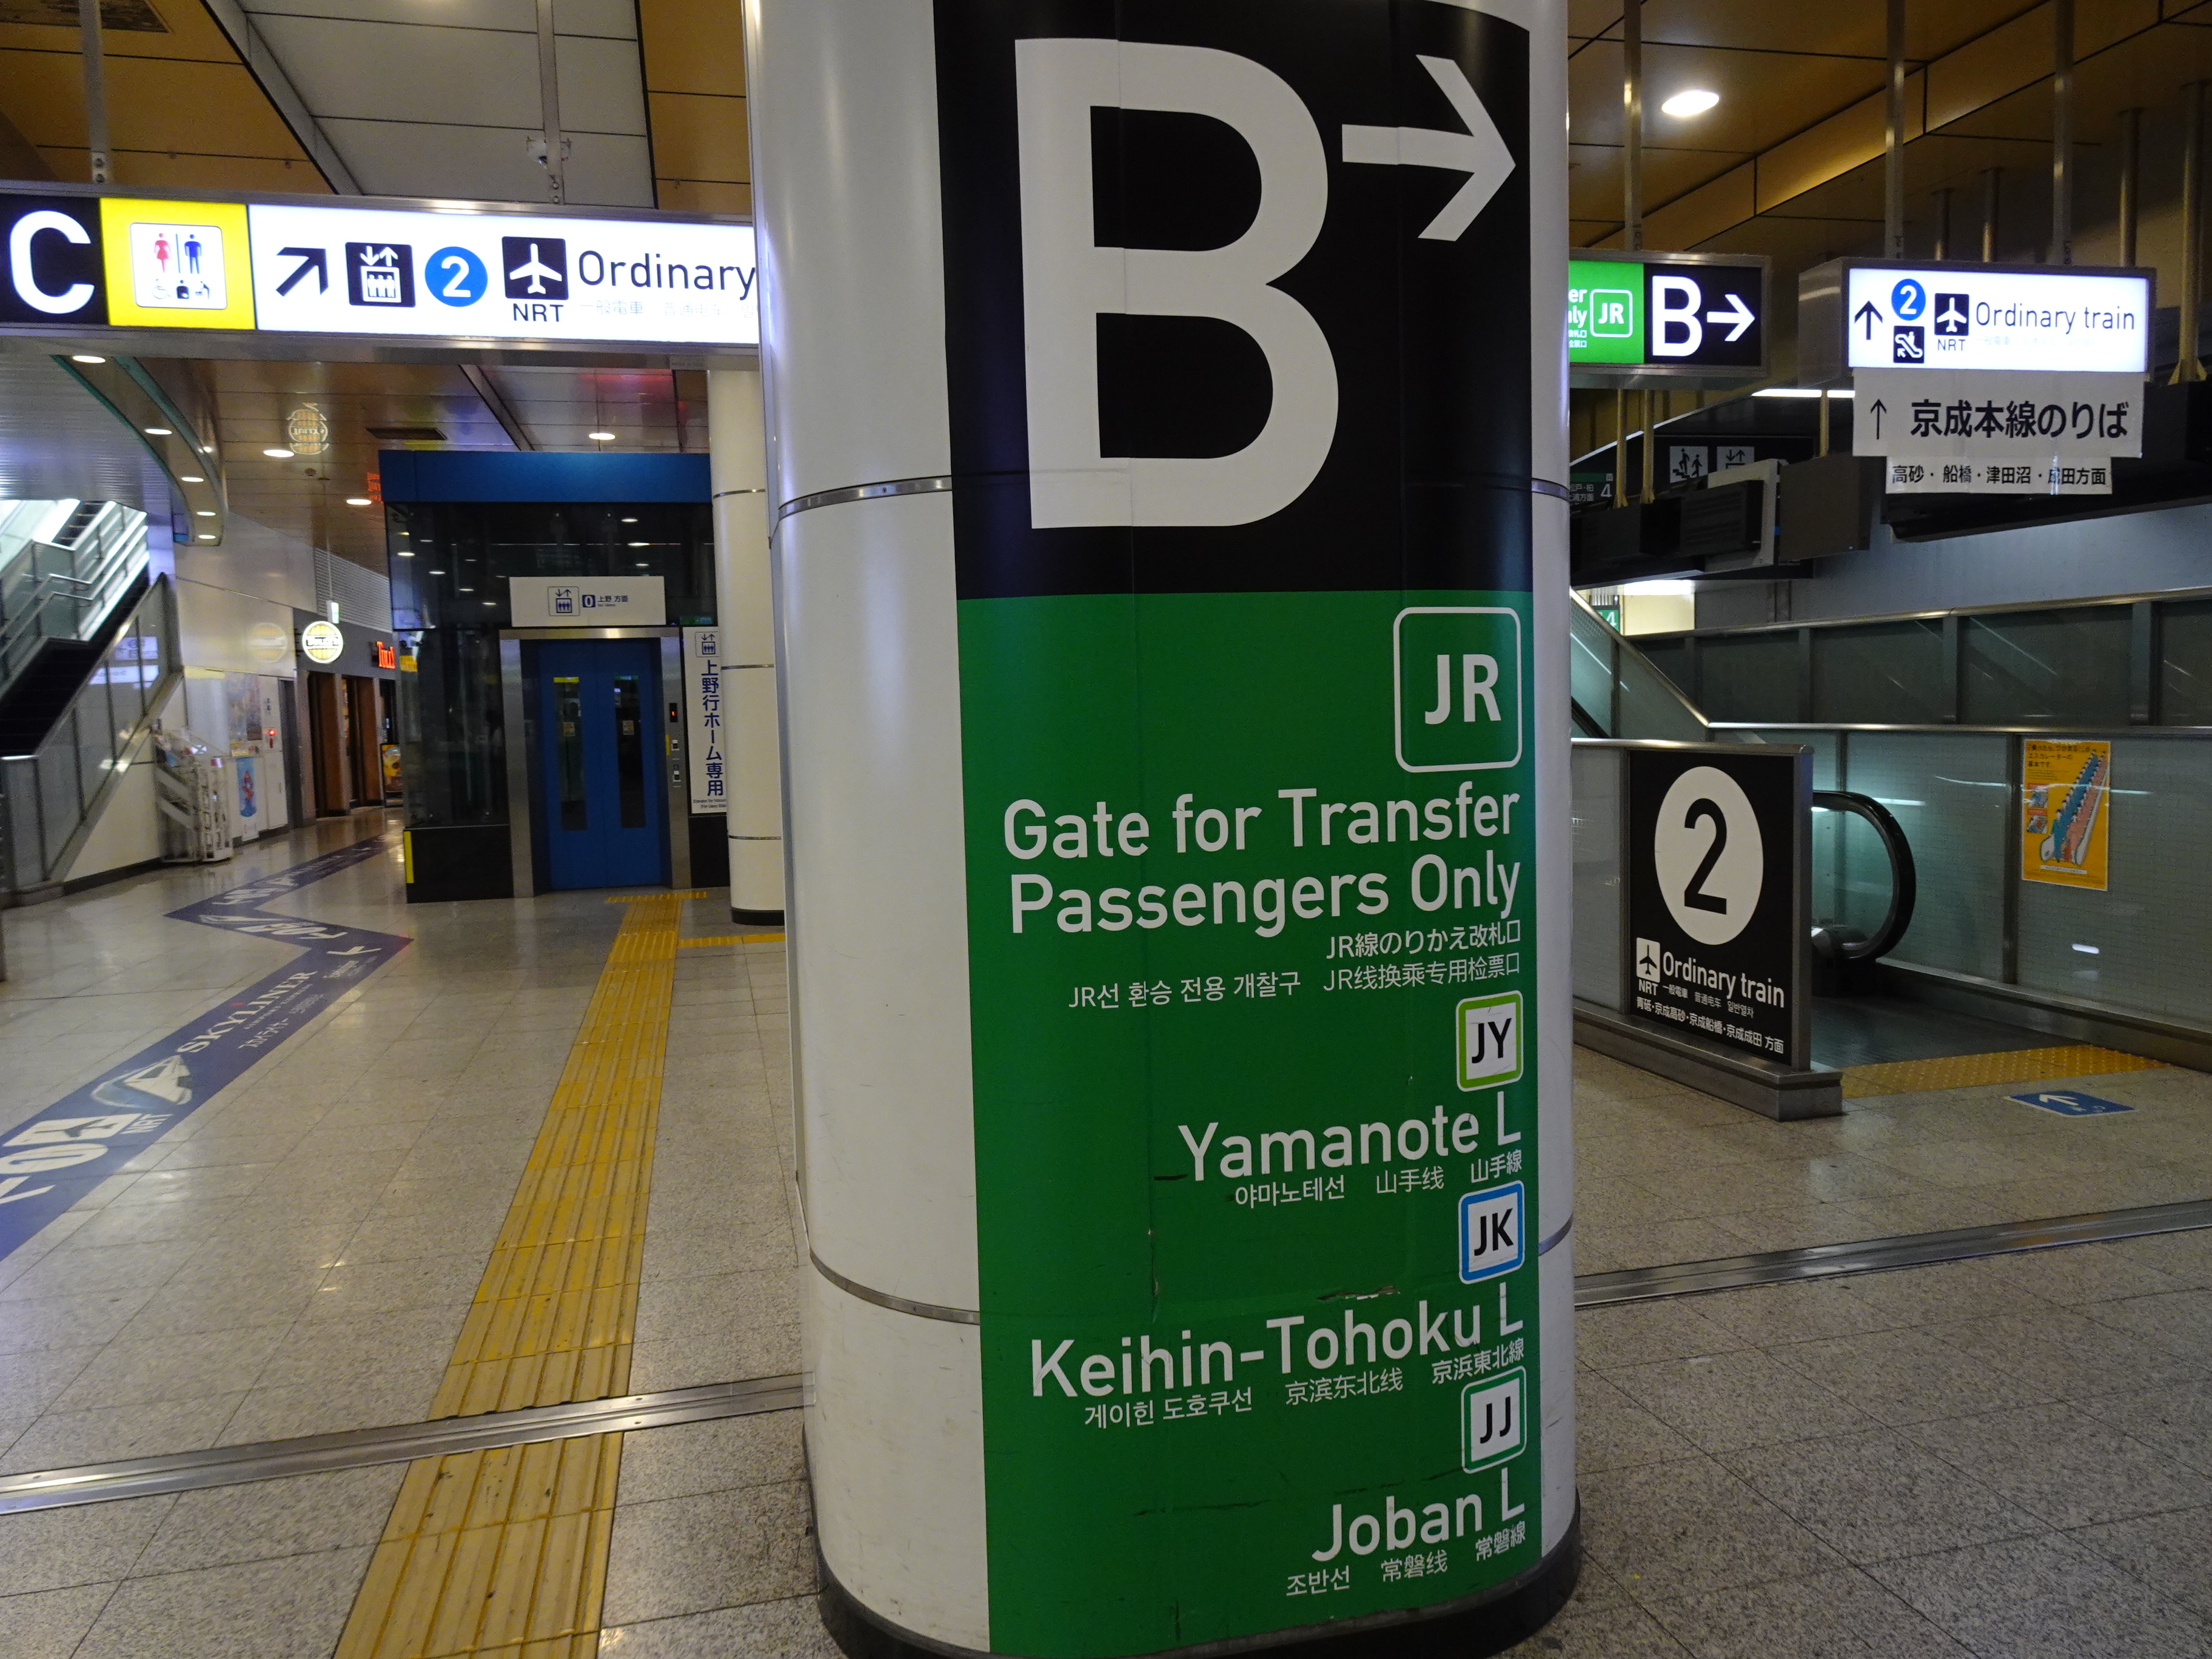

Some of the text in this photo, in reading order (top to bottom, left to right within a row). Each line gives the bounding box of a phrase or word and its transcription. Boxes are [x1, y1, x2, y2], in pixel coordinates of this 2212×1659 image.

[10, 211, 94, 313] C
[441, 255, 472, 298] 2
[579, 247, 756, 300] Ordinary
[1015, 38, 1339, 529] B
[514, 304, 563, 321] NRT
[1598, 303, 1624, 324] JR
[1652, 276, 1702, 356] B
[1900, 286, 1917, 314] 2
[1977, 302, 2134, 334] Ordinary train
[1937, 338, 1967, 352] NRT
[1911, 399, 2129, 438] 京成本線のりば
[1601, 483, 1612, 497] 4
[1425, 654, 1501, 724] JR
[700, 659, 723, 796] 上野行ホーム専用
[1005, 781, 1520, 859] Gate for Transfer
[1684, 797, 1727, 915] 2
[1011, 848, 1521, 938] Passengers Only
[1326, 919, 1521, 959] JR線のりかえ改札口
[1069, 953, 1521, 1008] JR선 환승 전용 개찰구 JR线换乘专用检票口
[1638, 979, 1659, 997] NRT
[1661, 949, 1783, 1010] Ordinary train
[1662, 984, 1689, 999] 一般電車
[176, 971, 318, 1053] SKYLINER
[1470, 1016, 1513, 1065] JY
[1764, 1036, 1785, 1054] 方面
[120, 1114, 173, 1134] NRT
[1178, 1091, 1521, 1185] Yamanote L
[1235, 1150, 1523, 1208] 야마노테선 山手线 山手線
[1473, 1208, 1515, 1256] JK
[1031, 1282, 1524, 1398] Keihin-Tohoku L
[1085, 1337, 1525, 1430] 게이힌 도호쿠선 京滨东北线 京浜東北線
[1480, 1396, 1512, 1444] JJ
[1312, 1467, 1526, 1562] Joban L
[1285, 1520, 1526, 1597] 조반선 常磐线 常磐線
